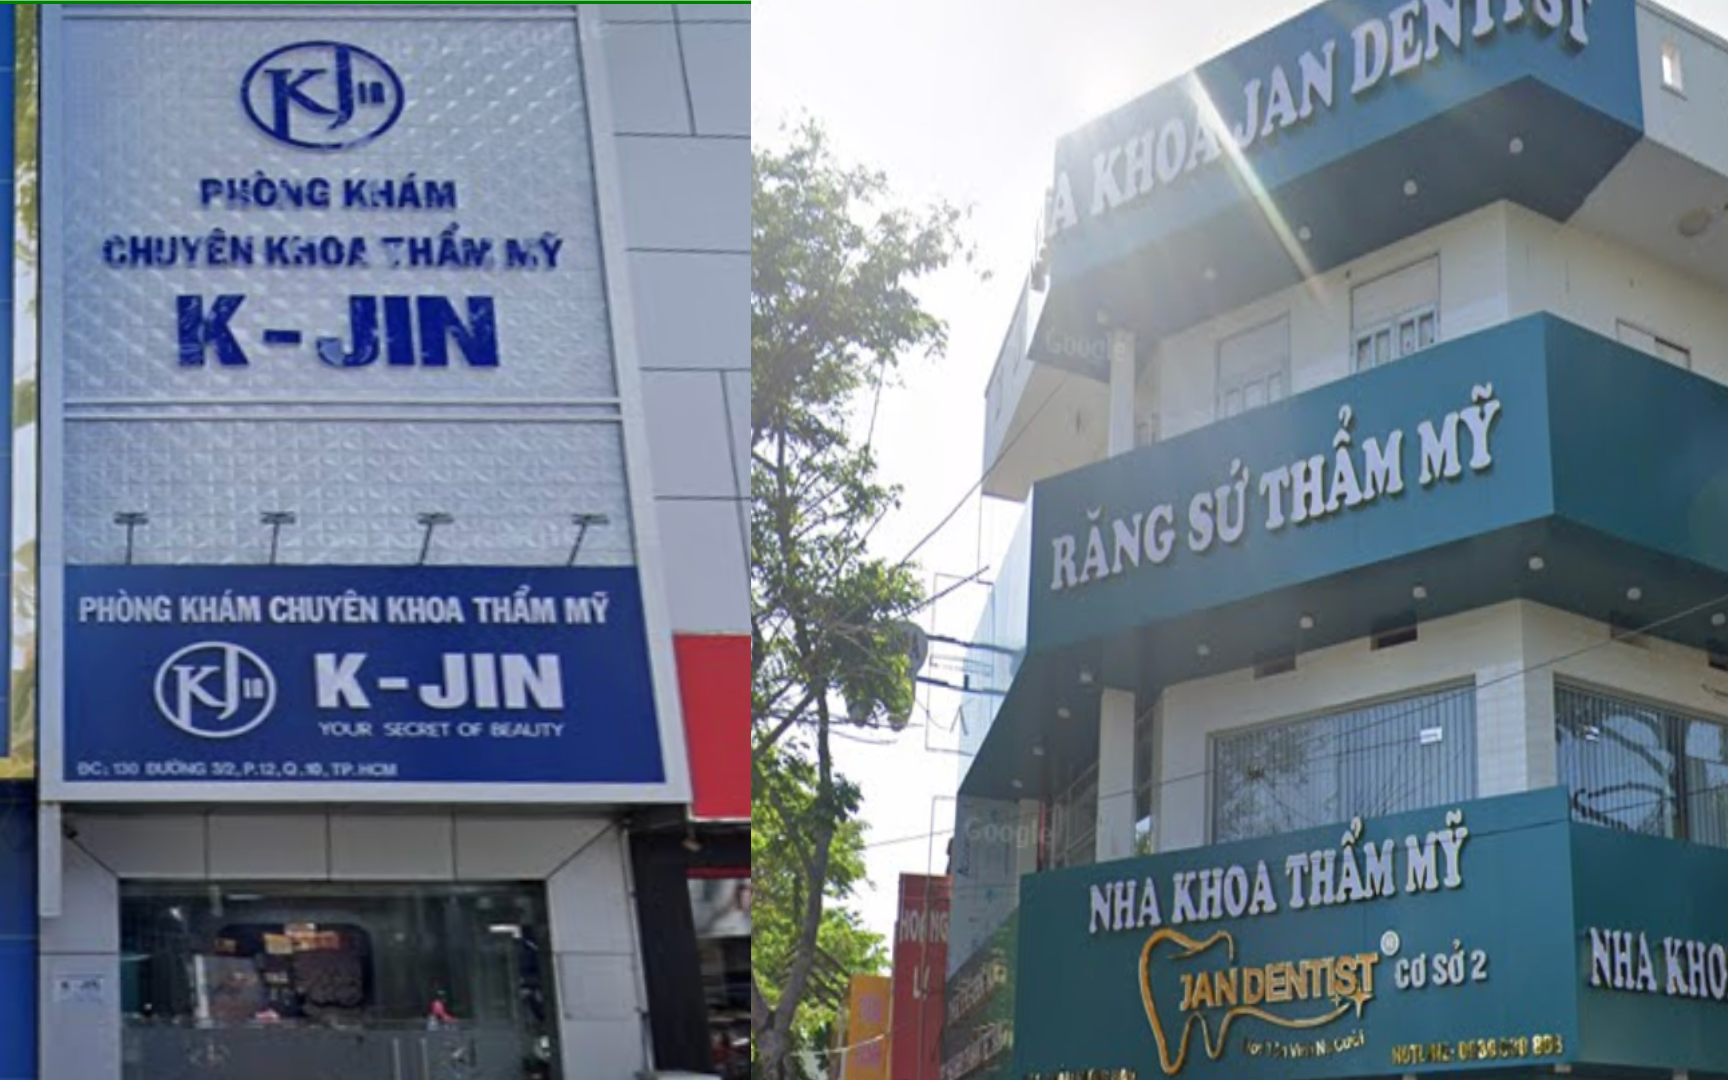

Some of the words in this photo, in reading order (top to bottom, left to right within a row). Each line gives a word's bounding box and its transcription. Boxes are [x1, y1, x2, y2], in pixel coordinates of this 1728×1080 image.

[1091, 116, 1222, 217] KHOA
[1234, 41, 1333, 149] JAN
[200, 171, 331, 208] PHÒNG
[343, 172, 457, 208] KHÁM
[103, 228, 255, 268] CHUYÊN
[265, 236, 367, 267] KHOA
[382, 222, 493, 268] THẨM
[505, 232, 563, 269] MỸ
[1050, 505, 1174, 590] RĂNG
[1189, 458, 1250, 552] SỨ
[1260, 405, 1403, 531] THẨM
[1418, 383, 1500, 485] MỸ
[79, 589, 172, 623] PHÒNG
[180, 589, 262, 623] KHÁM
[269, 589, 380, 623] CHUYÊN
[387, 596, 465, 623] KHOA
[472, 584, 557, 624] THẨM
[565, 591, 609, 624] MỸ
[318, 722, 372, 738] YOUR
[384, 722, 449, 738] SECRET
[457, 722, 483, 738] OF
[490, 722, 565, 738] BEAUTY
[1089, 880, 1162, 934] NHA
[1172, 860, 1277, 924] KHOA
[1285, 817, 1395, 903] THẨM
[1405, 810, 1468, 893] MỸ
[1180, 967, 1238, 1011] JAN
[1243, 952, 1379, 1004] DENTIST
[1394, 956, 1426, 989] CƠ
[1433, 939, 1465, 985] SỞ
[1471, 949, 1487, 981] 2
[1590, 926, 1657, 990] NHA
